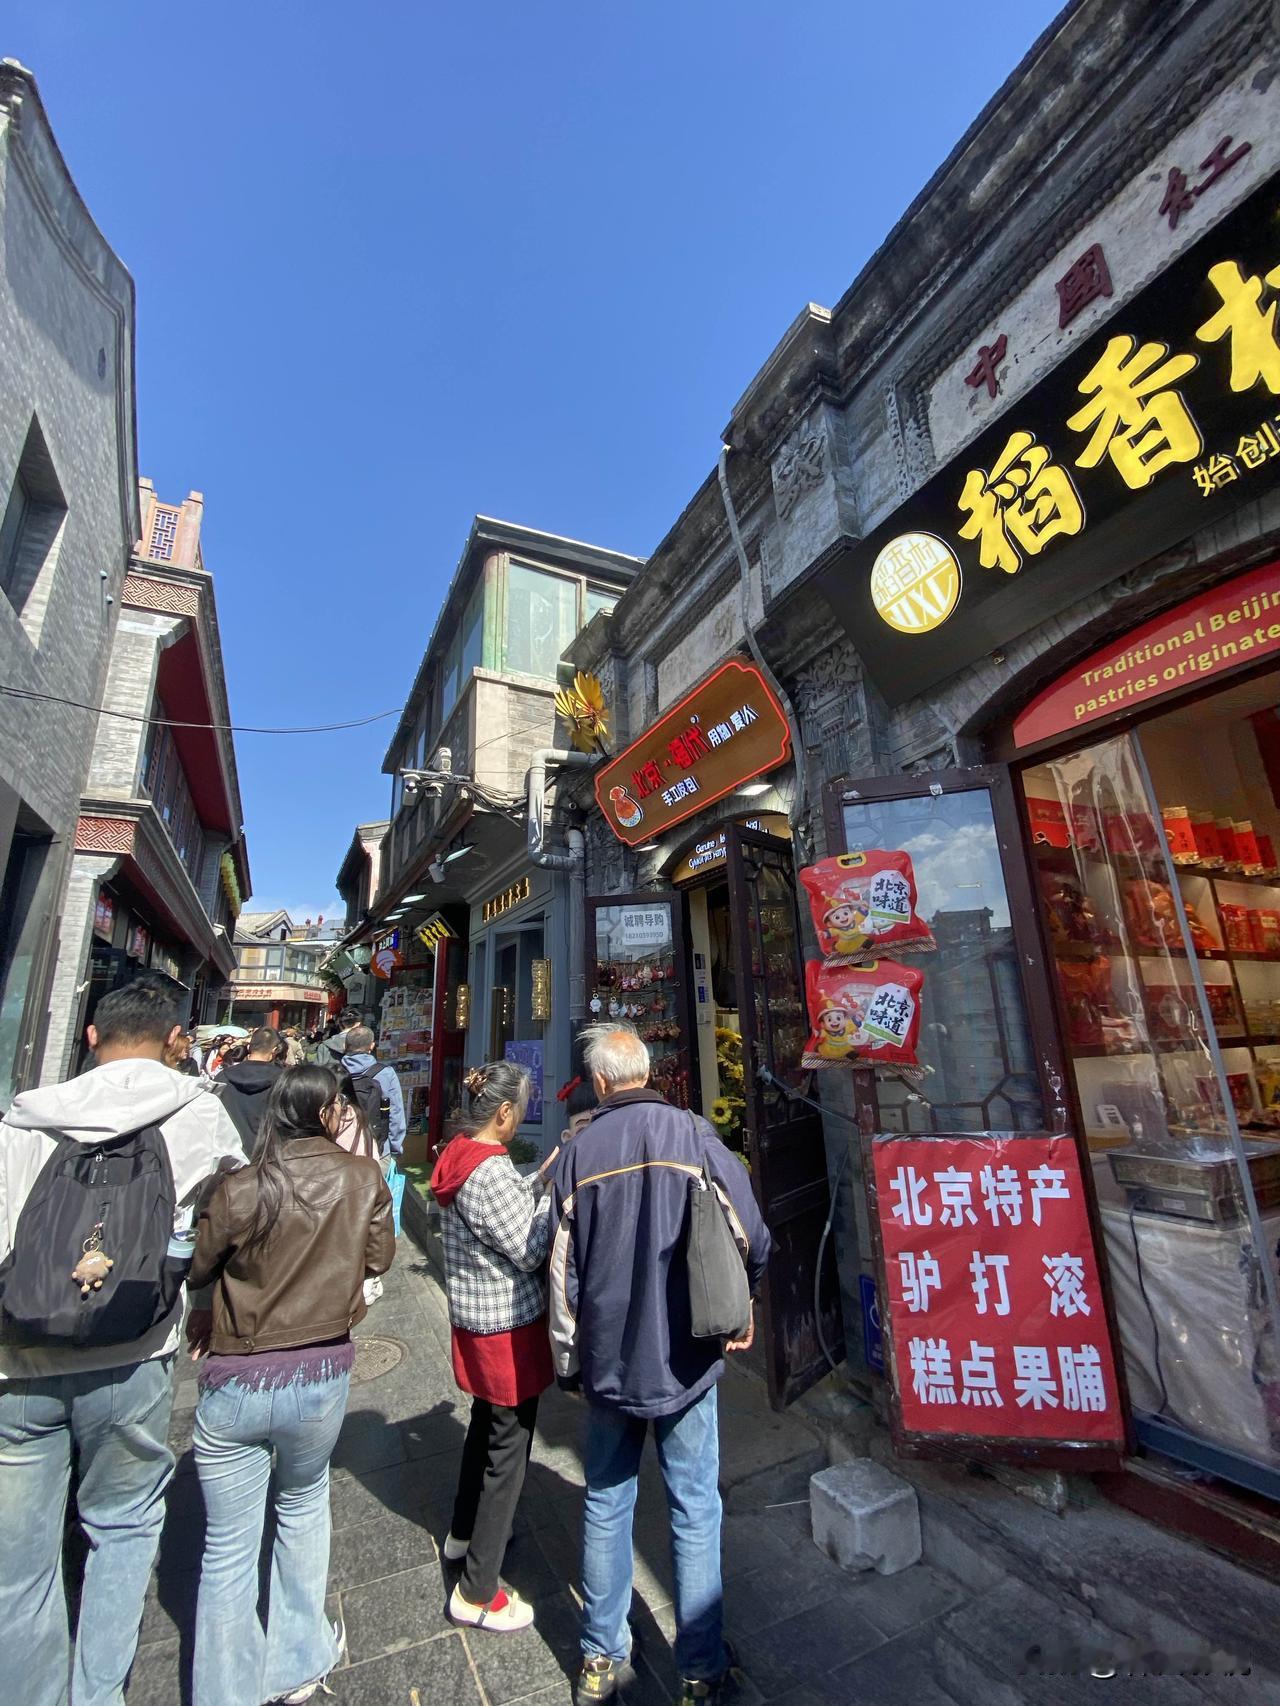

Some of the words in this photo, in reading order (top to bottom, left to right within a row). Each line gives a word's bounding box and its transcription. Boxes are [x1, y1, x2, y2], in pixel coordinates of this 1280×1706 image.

[1192, 415, 1280, 497] 始创
[1081, 621, 1206, 687] Traditional
[1073, 673, 1158, 720] pastries
[872, 892, 908, 914] 味道
[874, 878, 908, 896] 北京
[869, 1008, 905, 1036] 味道
[875, 992, 911, 1017] 北京
[889, 1164, 1071, 1228] 北京特产
